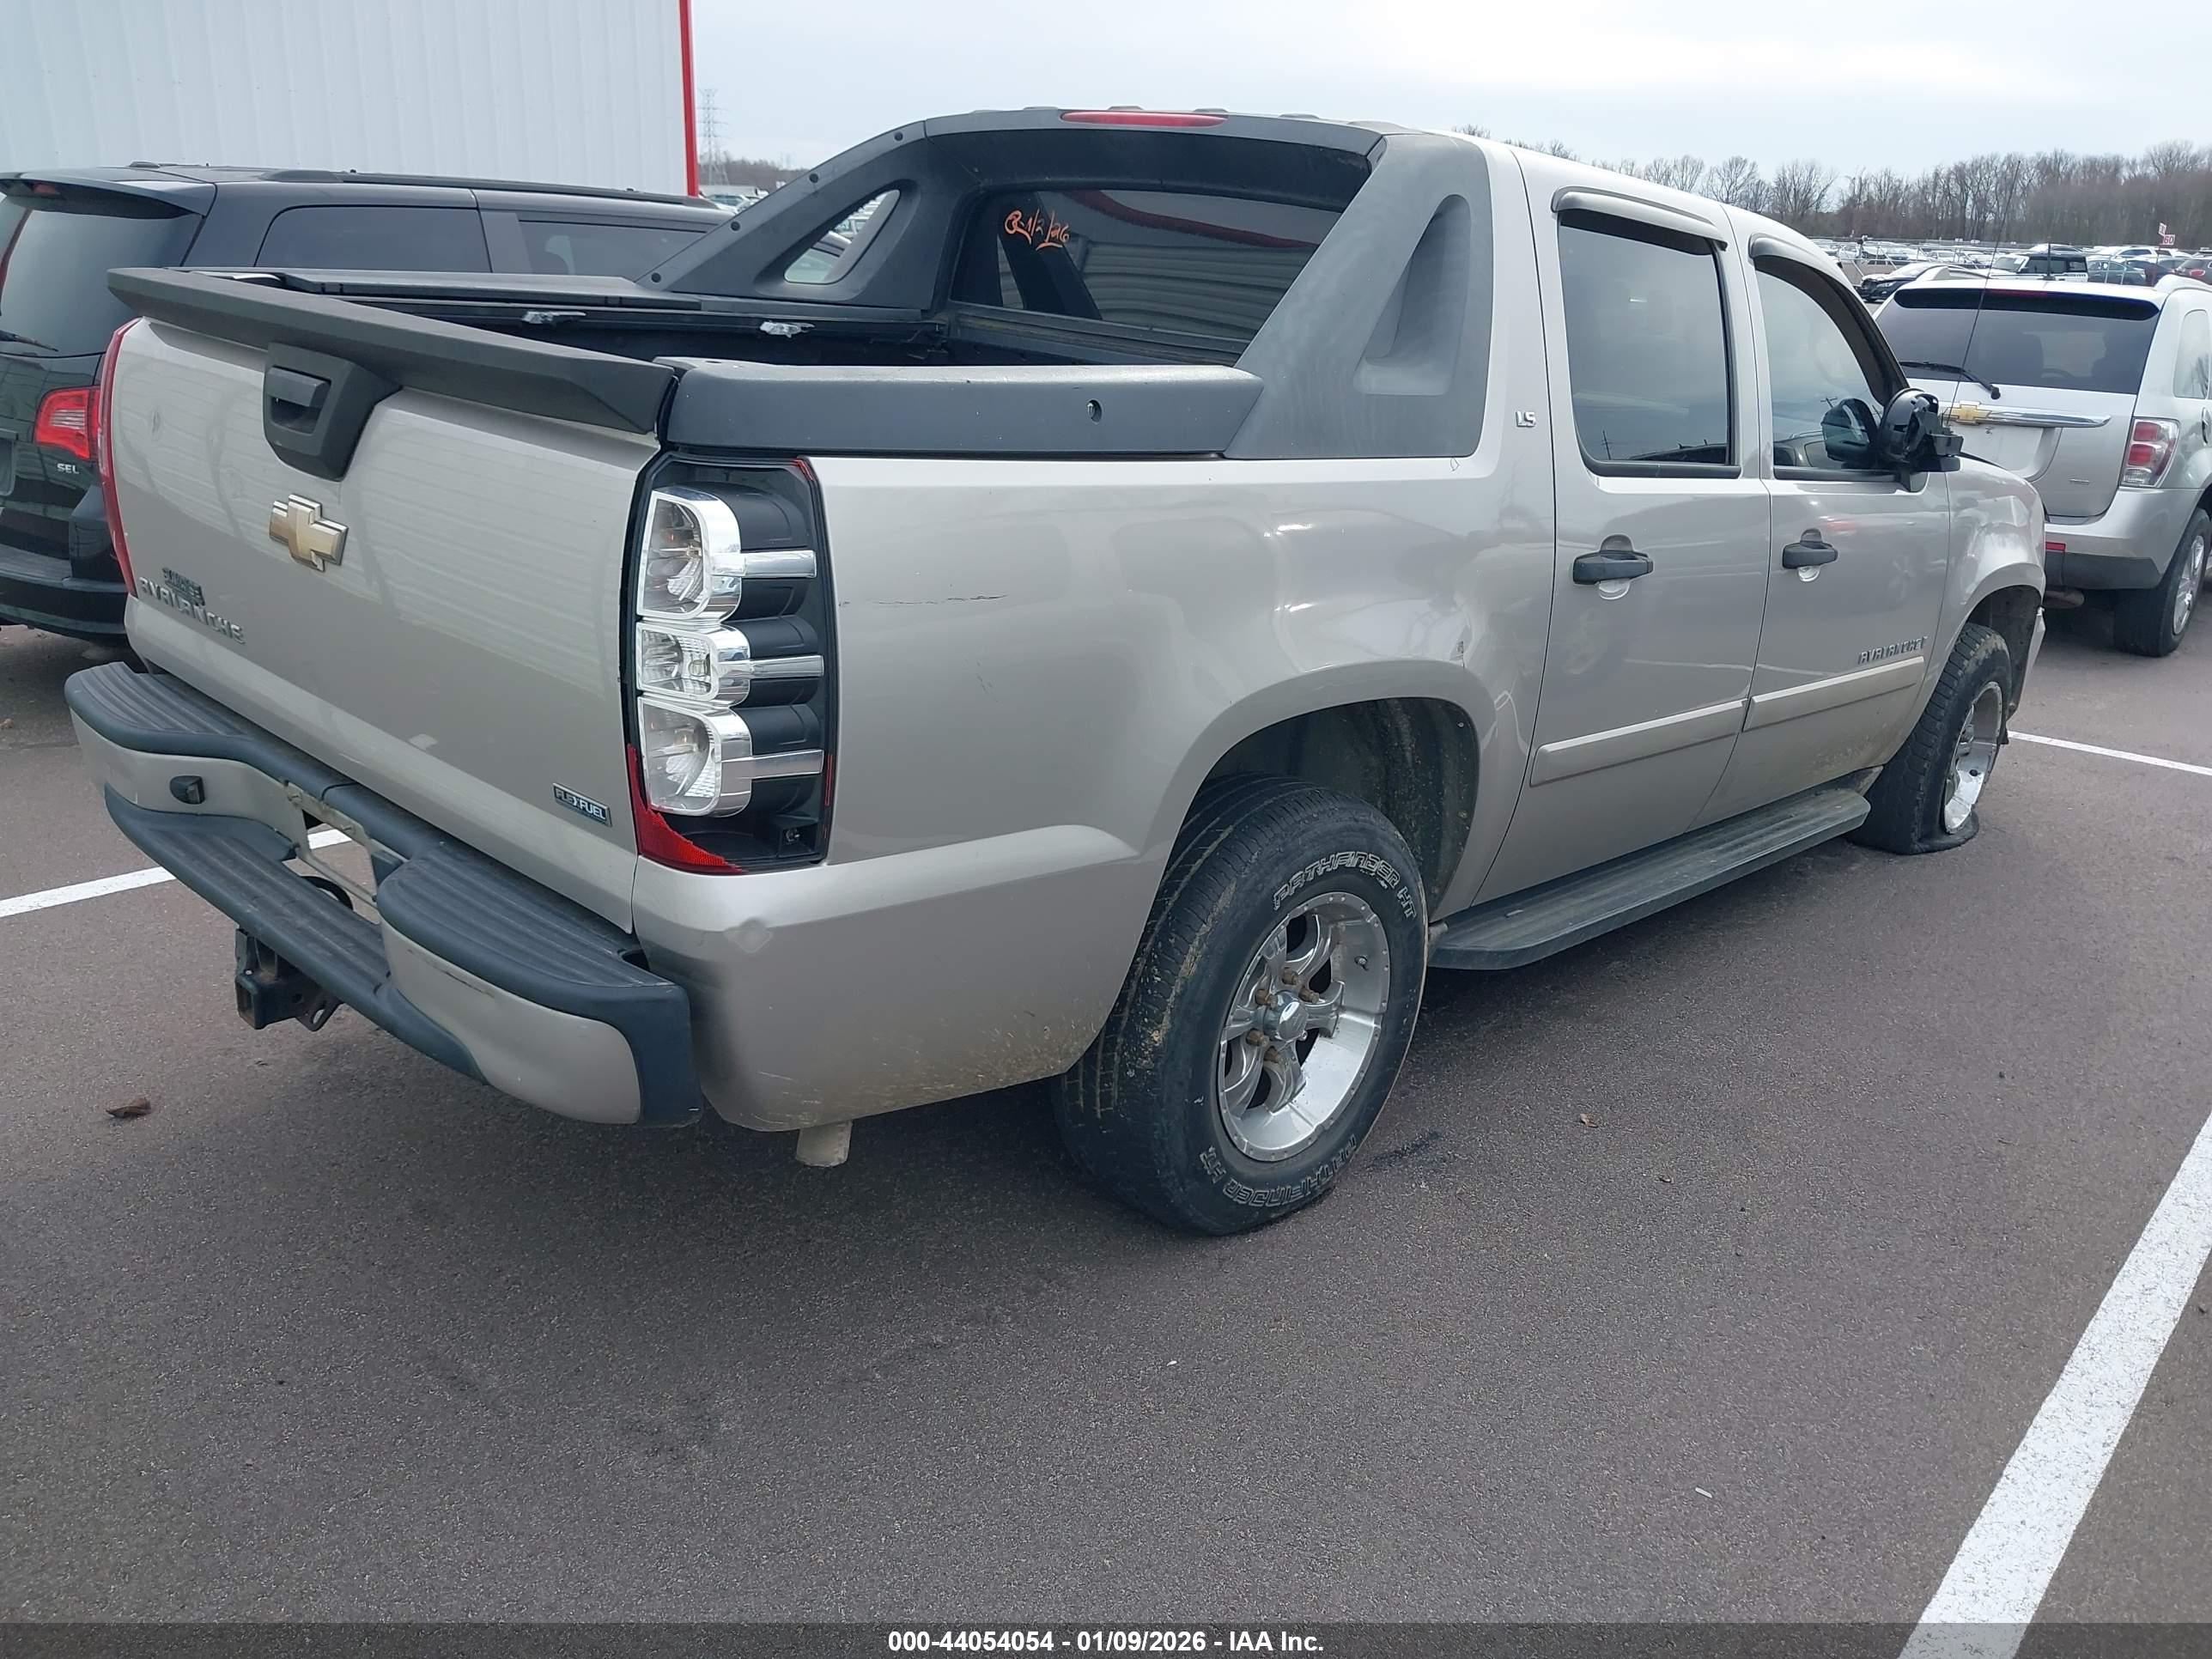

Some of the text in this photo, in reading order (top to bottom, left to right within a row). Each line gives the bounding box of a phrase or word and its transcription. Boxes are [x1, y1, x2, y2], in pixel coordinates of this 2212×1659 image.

[1516, 411, 1536, 428] LS
[57, 463, 80, 475] SEL
[1273, 851, 1417, 920] PATHFINDER HT
